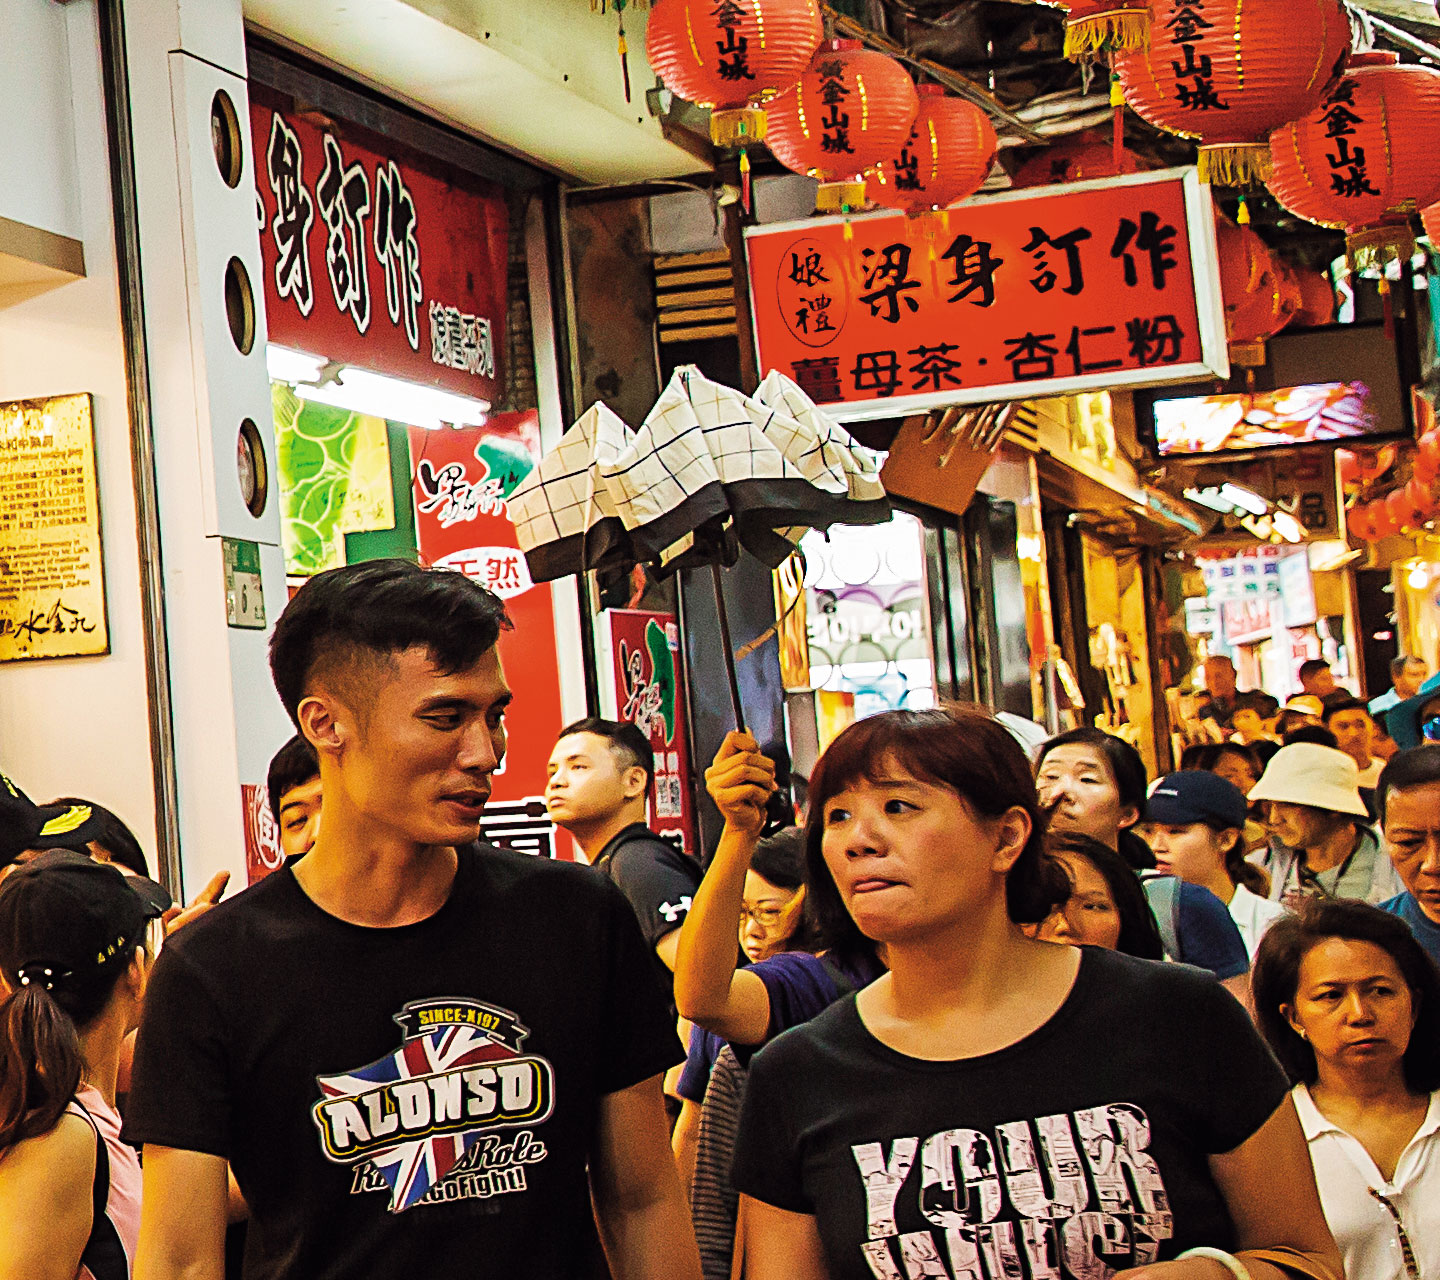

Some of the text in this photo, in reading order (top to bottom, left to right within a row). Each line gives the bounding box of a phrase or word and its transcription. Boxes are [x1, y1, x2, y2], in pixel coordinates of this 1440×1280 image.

[260, 113, 423, 352] 身訂作
[858, 210, 1180, 325] 梁身訂作
[326, 1062, 534, 1149] ALONSO
[851, 1103, 1173, 1239] YOUR
